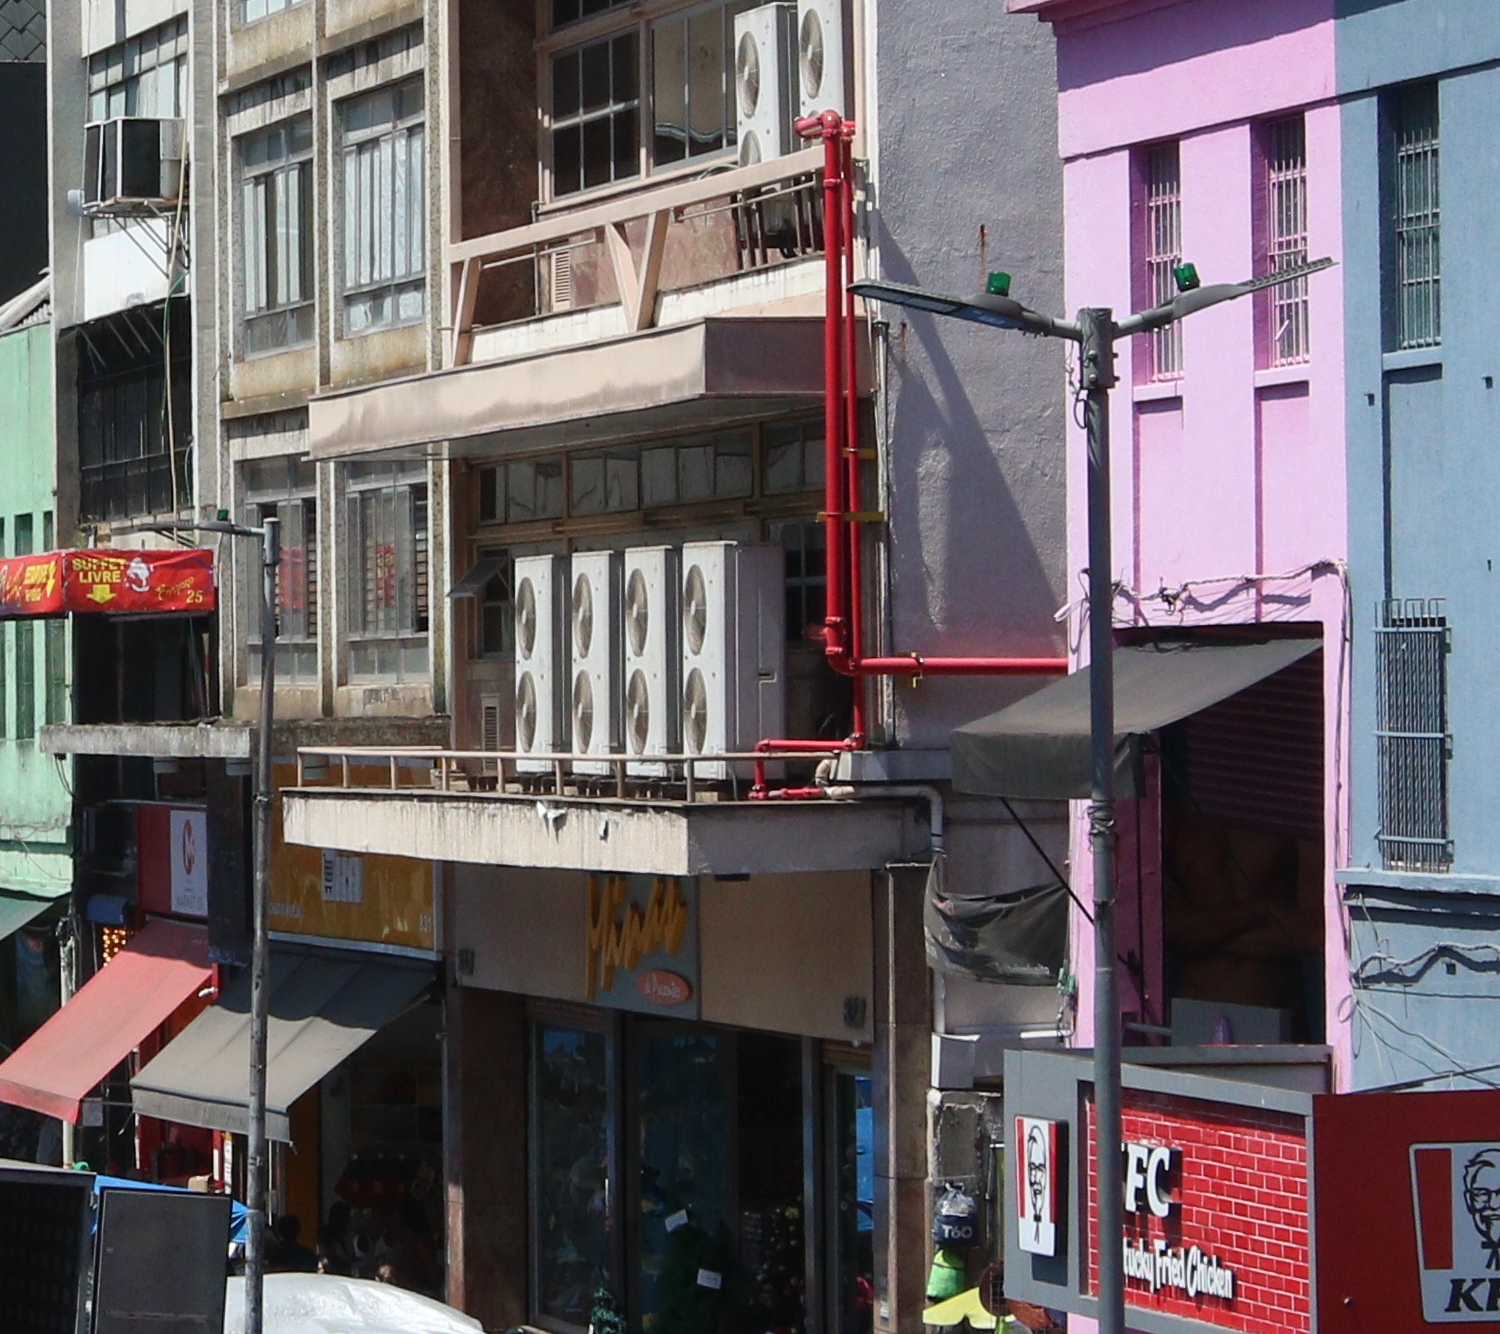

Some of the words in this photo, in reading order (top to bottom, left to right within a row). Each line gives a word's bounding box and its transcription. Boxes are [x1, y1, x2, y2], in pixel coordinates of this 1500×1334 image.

[79, 571, 122, 584] LIVRE
[185, 589, 204, 603] 25
[1122, 1142, 1171, 1218] FC
[1122, 1237, 1156, 1294] tucky
[1153, 1239, 1186, 1291] Fried
[1185, 1244, 1234, 1300] Chicken
